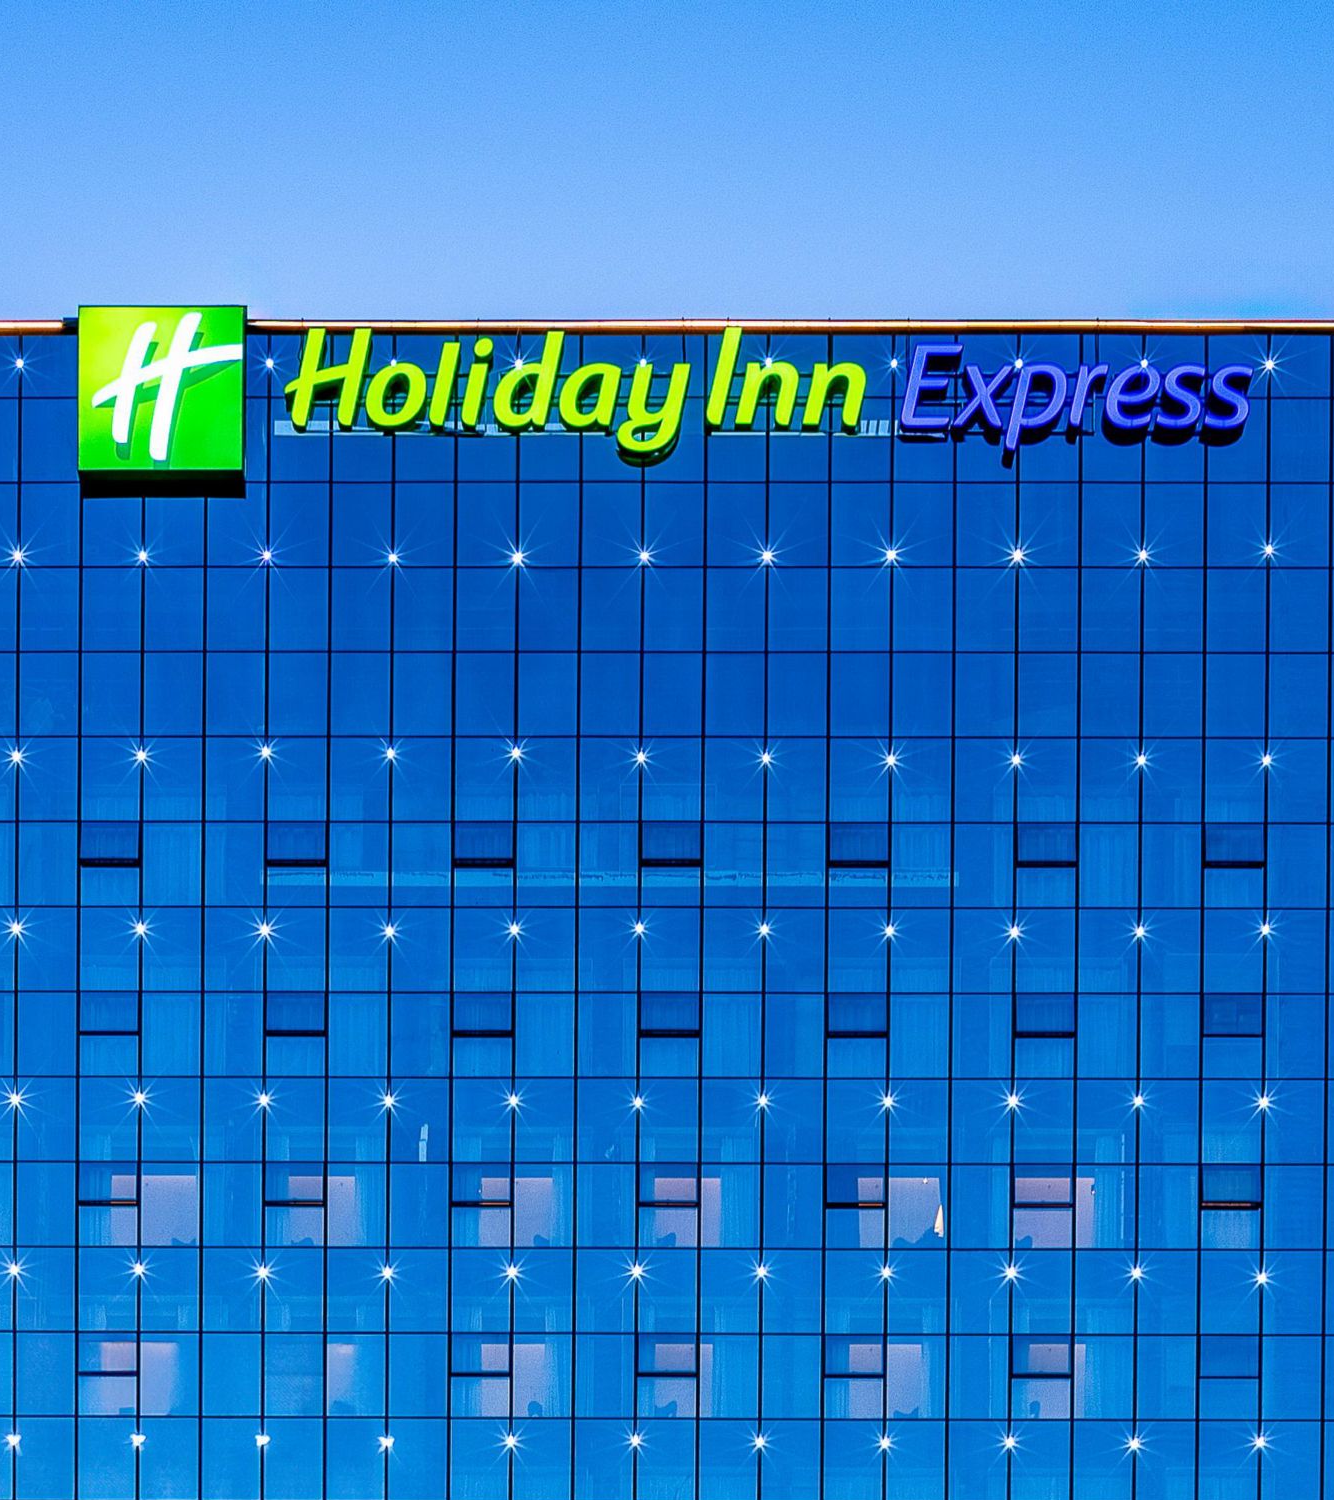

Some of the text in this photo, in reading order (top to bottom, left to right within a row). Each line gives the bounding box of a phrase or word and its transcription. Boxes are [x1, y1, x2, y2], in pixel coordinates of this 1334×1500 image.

[284, 327, 1254, 452] Holiday Inn Express
